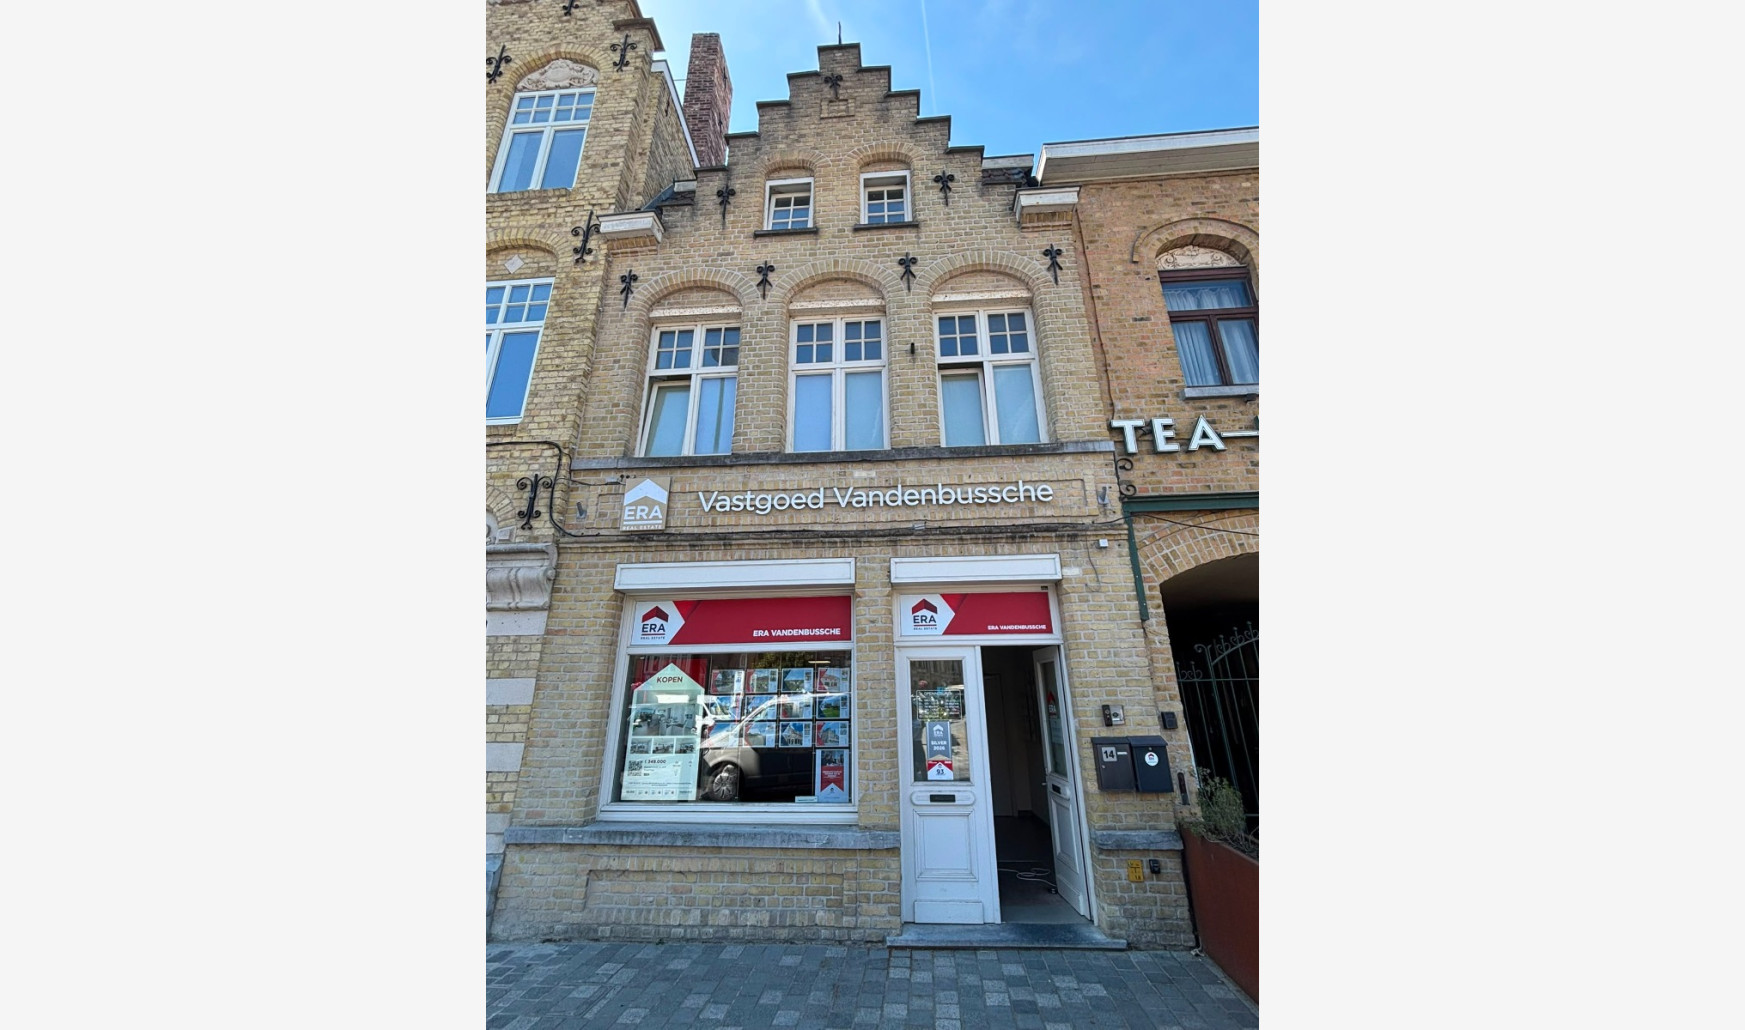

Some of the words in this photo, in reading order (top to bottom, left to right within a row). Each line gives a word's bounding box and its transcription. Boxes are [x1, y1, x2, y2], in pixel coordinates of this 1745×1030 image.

[698, 487, 825, 515] Vastgoed
[832, 480, 1054, 509] Vandenbussche
[623, 505, 663, 520] ERA
[913, 615, 937, 624] ERA
[641, 623, 666, 633] ERA
[752, 629, 769, 637] ERA
[771, 628, 841, 637] VANDENBUSSCHE
[1103, 750, 1115, 759] 14
